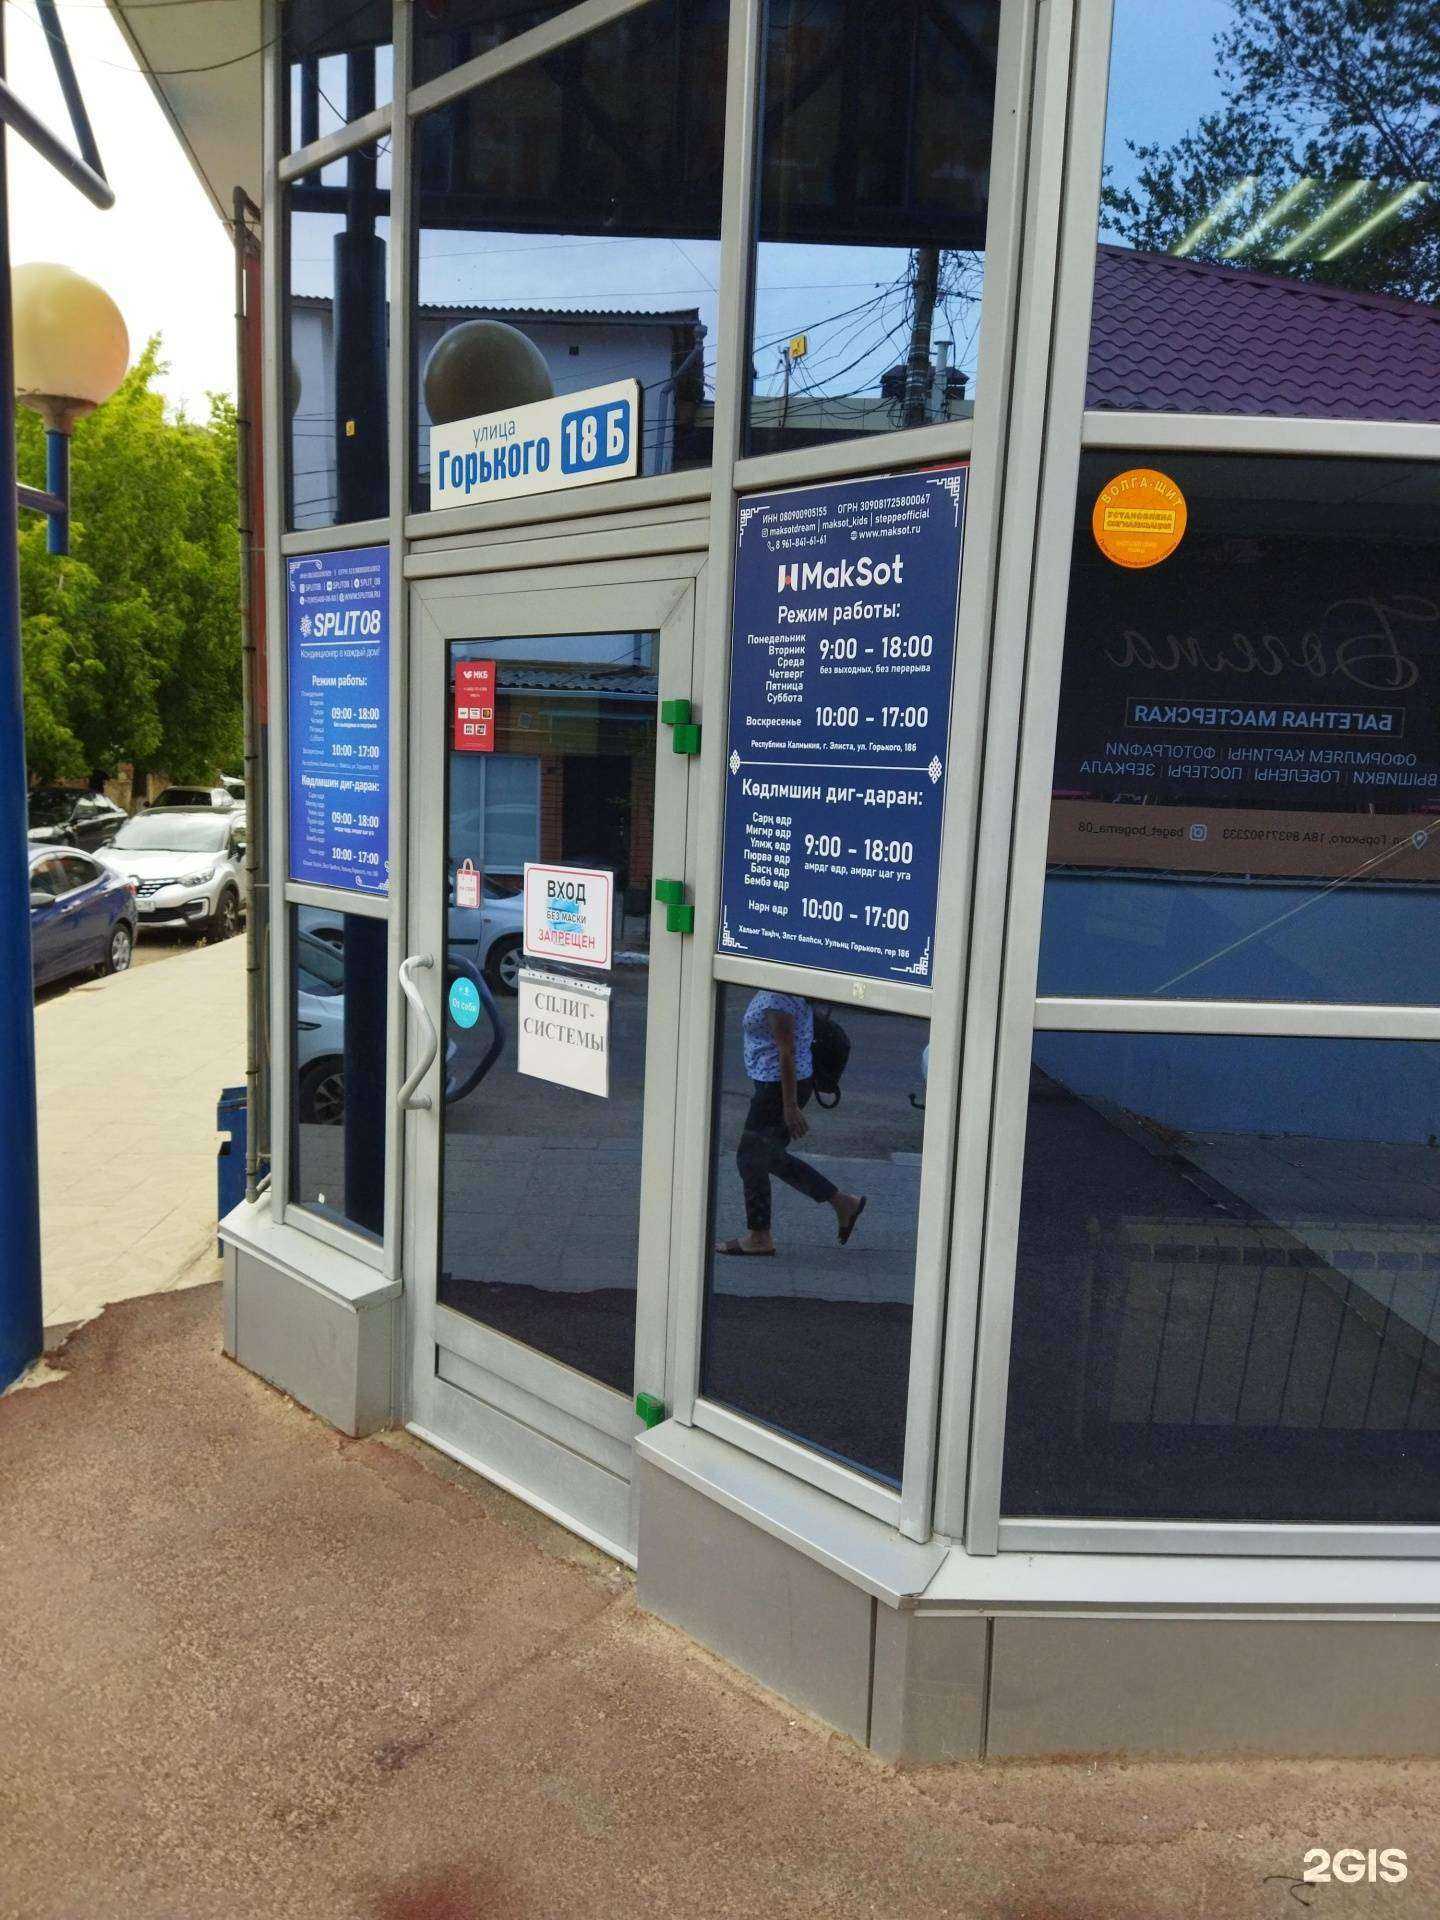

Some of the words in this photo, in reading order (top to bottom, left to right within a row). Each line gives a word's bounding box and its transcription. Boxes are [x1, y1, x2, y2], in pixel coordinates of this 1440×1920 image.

[472, 419, 516, 448] улица
[438, 436, 550, 495] Горького
[763, 513, 778, 524] ИНН
[837, 502, 858, 514] ОГРН
[770, 523, 816, 536] maksotdream
[875, 508, 930, 525] steppeofficial
[859, 525, 921, 539] www.maksot.ru
[801, 554, 904, 591] MakSot
[313, 609, 381, 638] SPLIT08
[778, 604, 828, 624] Режим
[833, 601, 901, 625] работы:
[747, 633, 806, 645] Понедельник
[768, 645, 805, 657] Вторник
[819, 638, 857, 660] 9:00
[881, 635, 933, 659] 18:00
[777, 657, 805, 668] Среда
[819, 665, 832, 674] без
[834, 665, 874, 675] выходных,
[876, 663, 889, 673] без
[891, 663, 931, 675] перерыва
[312, 674, 337, 687] Режим
[338, 673, 368, 689] работы:
[769, 669, 804, 680] Четверг
[765, 681, 804, 692] Пятница
[767, 693, 803, 704] Суббота
[331, 707, 352, 720] 09:00
[358, 707, 380, 721] 18:00
[746, 716, 802, 728] Воскресенье
[815, 706, 859, 727] 10:00
[881, 707, 929, 728] 17:00
[331, 744, 352, 757] 10:00
[358, 745, 380, 758] 17:00
[751, 740, 786, 750] Республика
[826, 785, 923, 808] диг-даран:
[331, 811, 352, 825] 09:00
[358, 814, 380, 829] 18:00
[331, 847, 352, 861] 10:00
[358, 851, 379, 865] 17:00
[804, 833, 841, 858] 9:00
[864, 838, 913, 865] 18:00
[879, 870, 894, 879] цаг
[896, 871, 911, 882] уга
[547, 879, 587, 906] ВХОД
[546, 910, 561, 922] БЕЗ
[561, 912, 587, 925] МАСКИ
[801, 897, 843, 922] 10:00
[864, 905, 909, 931] 17:00
[538, 928, 596, 950] ЗАПРЕЩЕН
[534, 992, 595, 1021] СПЛИТ-
[523, 1017, 604, 1053] СИСТЕМЫ
